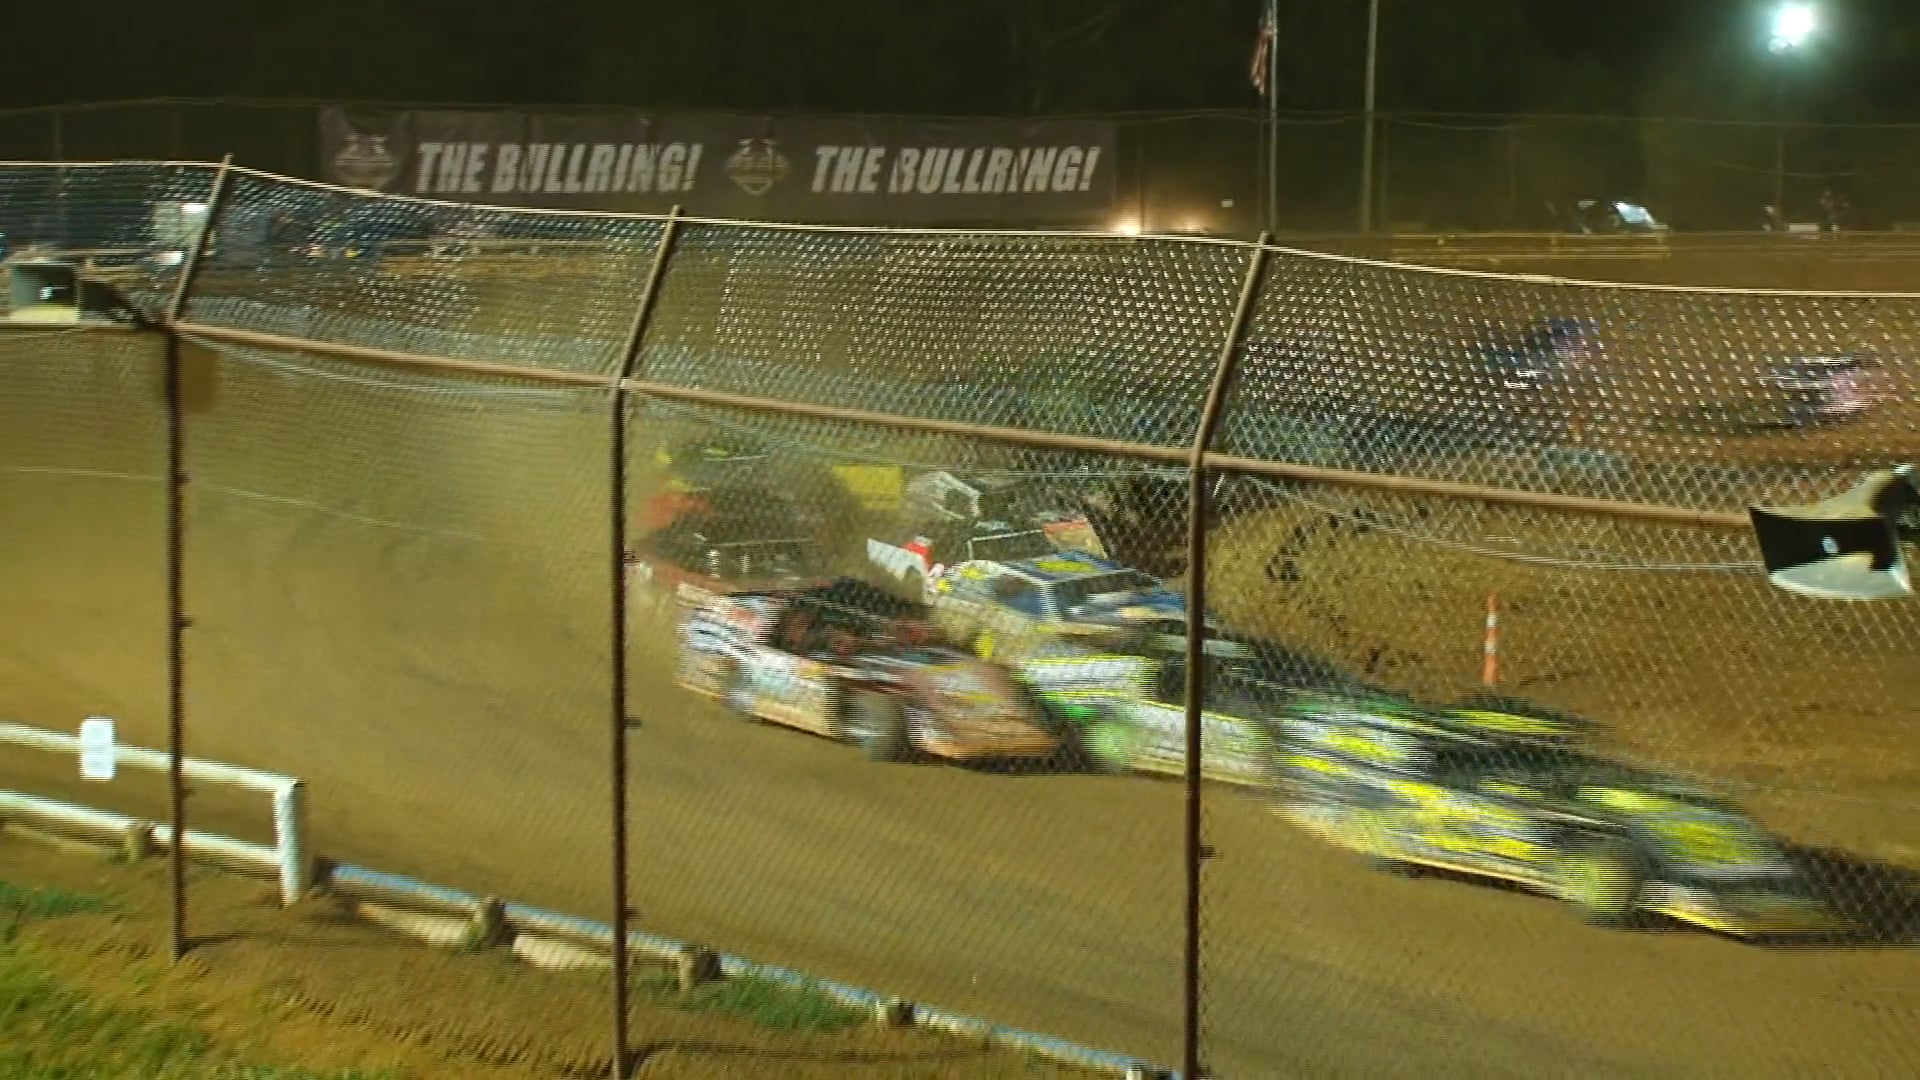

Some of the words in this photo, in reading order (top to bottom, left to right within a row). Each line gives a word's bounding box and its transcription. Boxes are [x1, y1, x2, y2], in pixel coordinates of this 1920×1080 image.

[415, 142, 488, 193] THE
[491, 142, 703, 193] BULLRING!
[811, 146, 886, 193] THE
[888, 146, 1101, 193] BULLRING!
